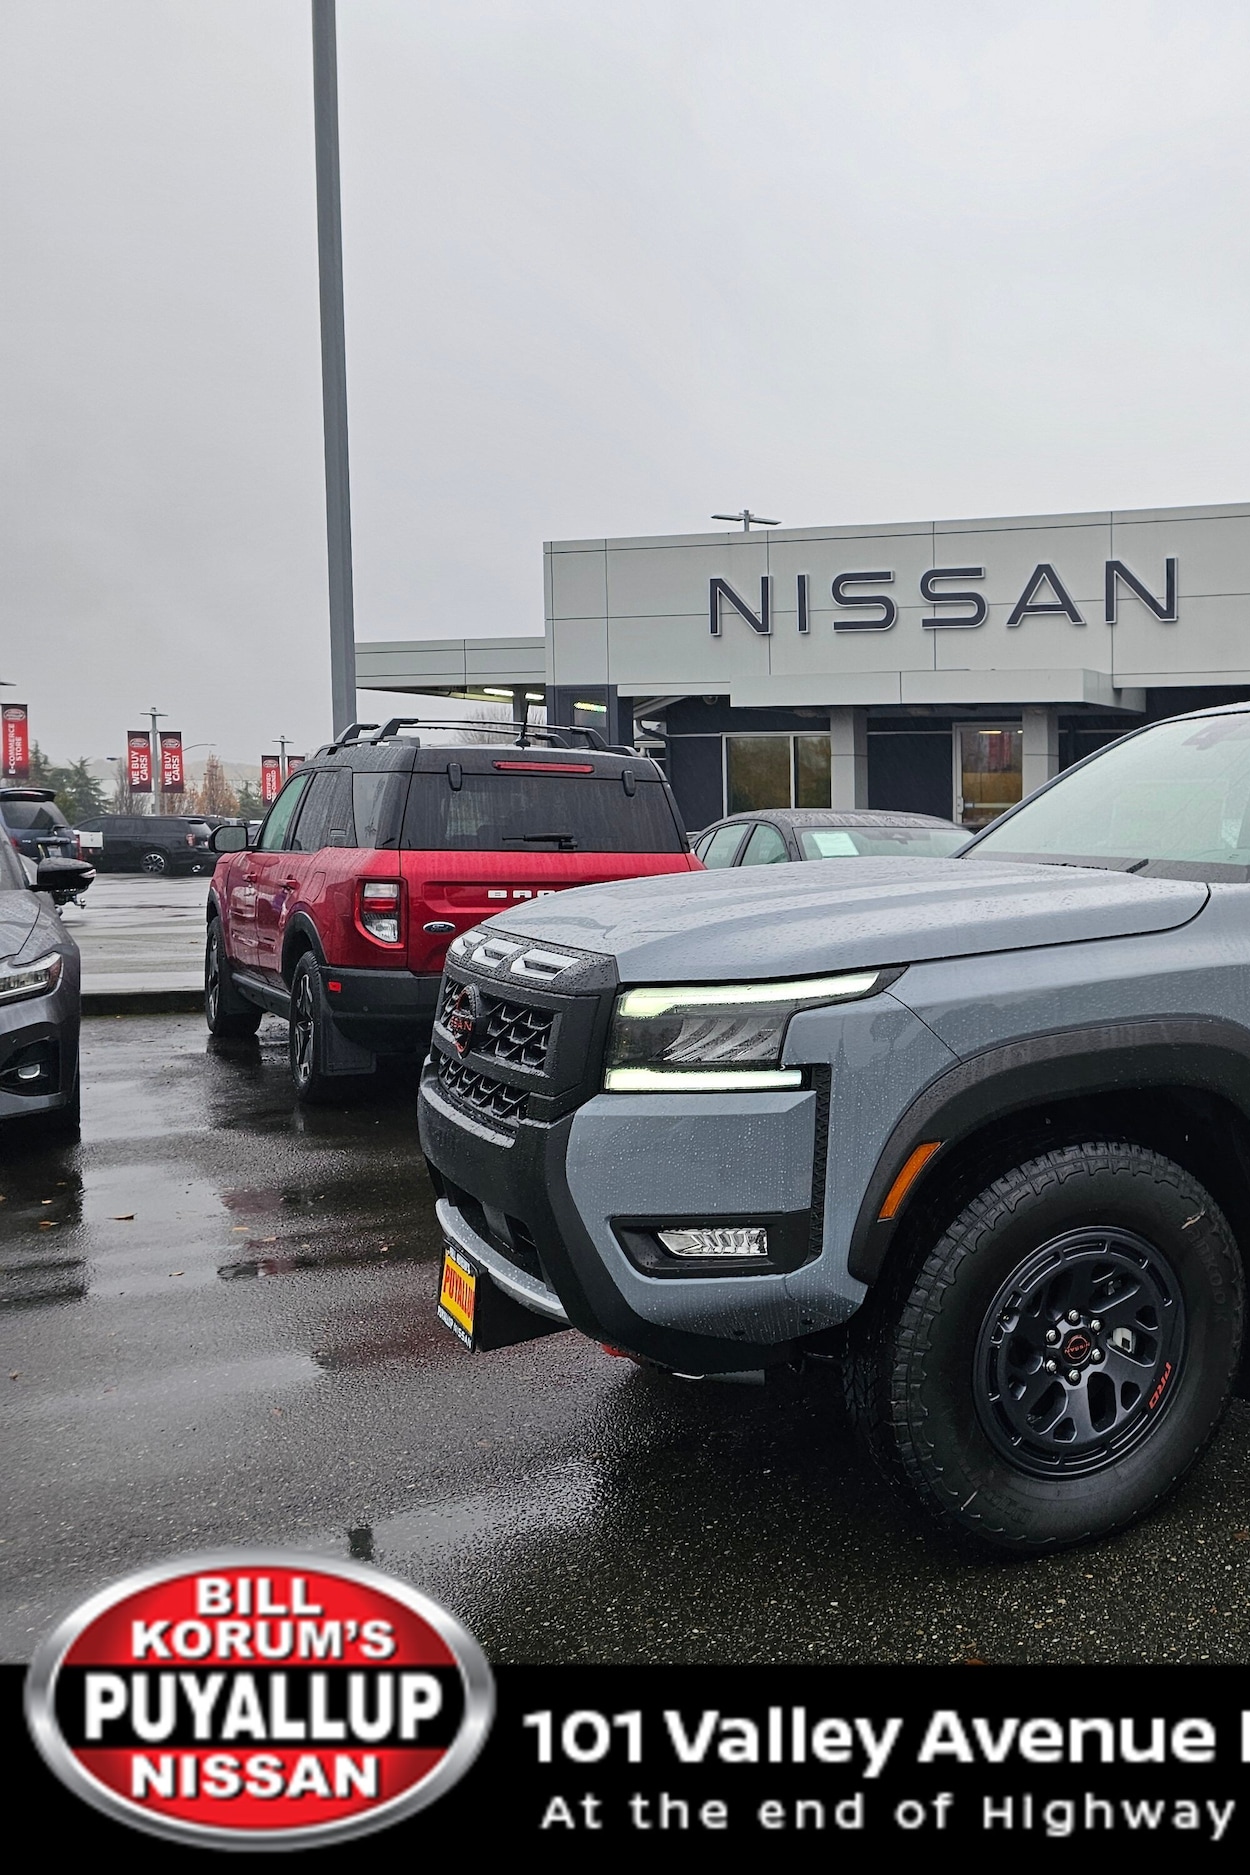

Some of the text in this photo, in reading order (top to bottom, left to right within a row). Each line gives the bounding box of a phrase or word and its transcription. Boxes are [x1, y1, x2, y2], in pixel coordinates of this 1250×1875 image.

[709, 556, 1178, 636] NISSAN
[8, 723, 16, 775] E-COMMERCE
[15, 736, 23, 762] STORE
[131, 750, 139, 769] BUY
[163, 751, 171, 769] BUY
[131, 770, 140, 786] WE
[140, 754, 149, 781] CARS!
[164, 771, 172, 786] WE
[172, 755, 180, 782] CARS!
[1148, 1361, 1172, 1409] PRO
